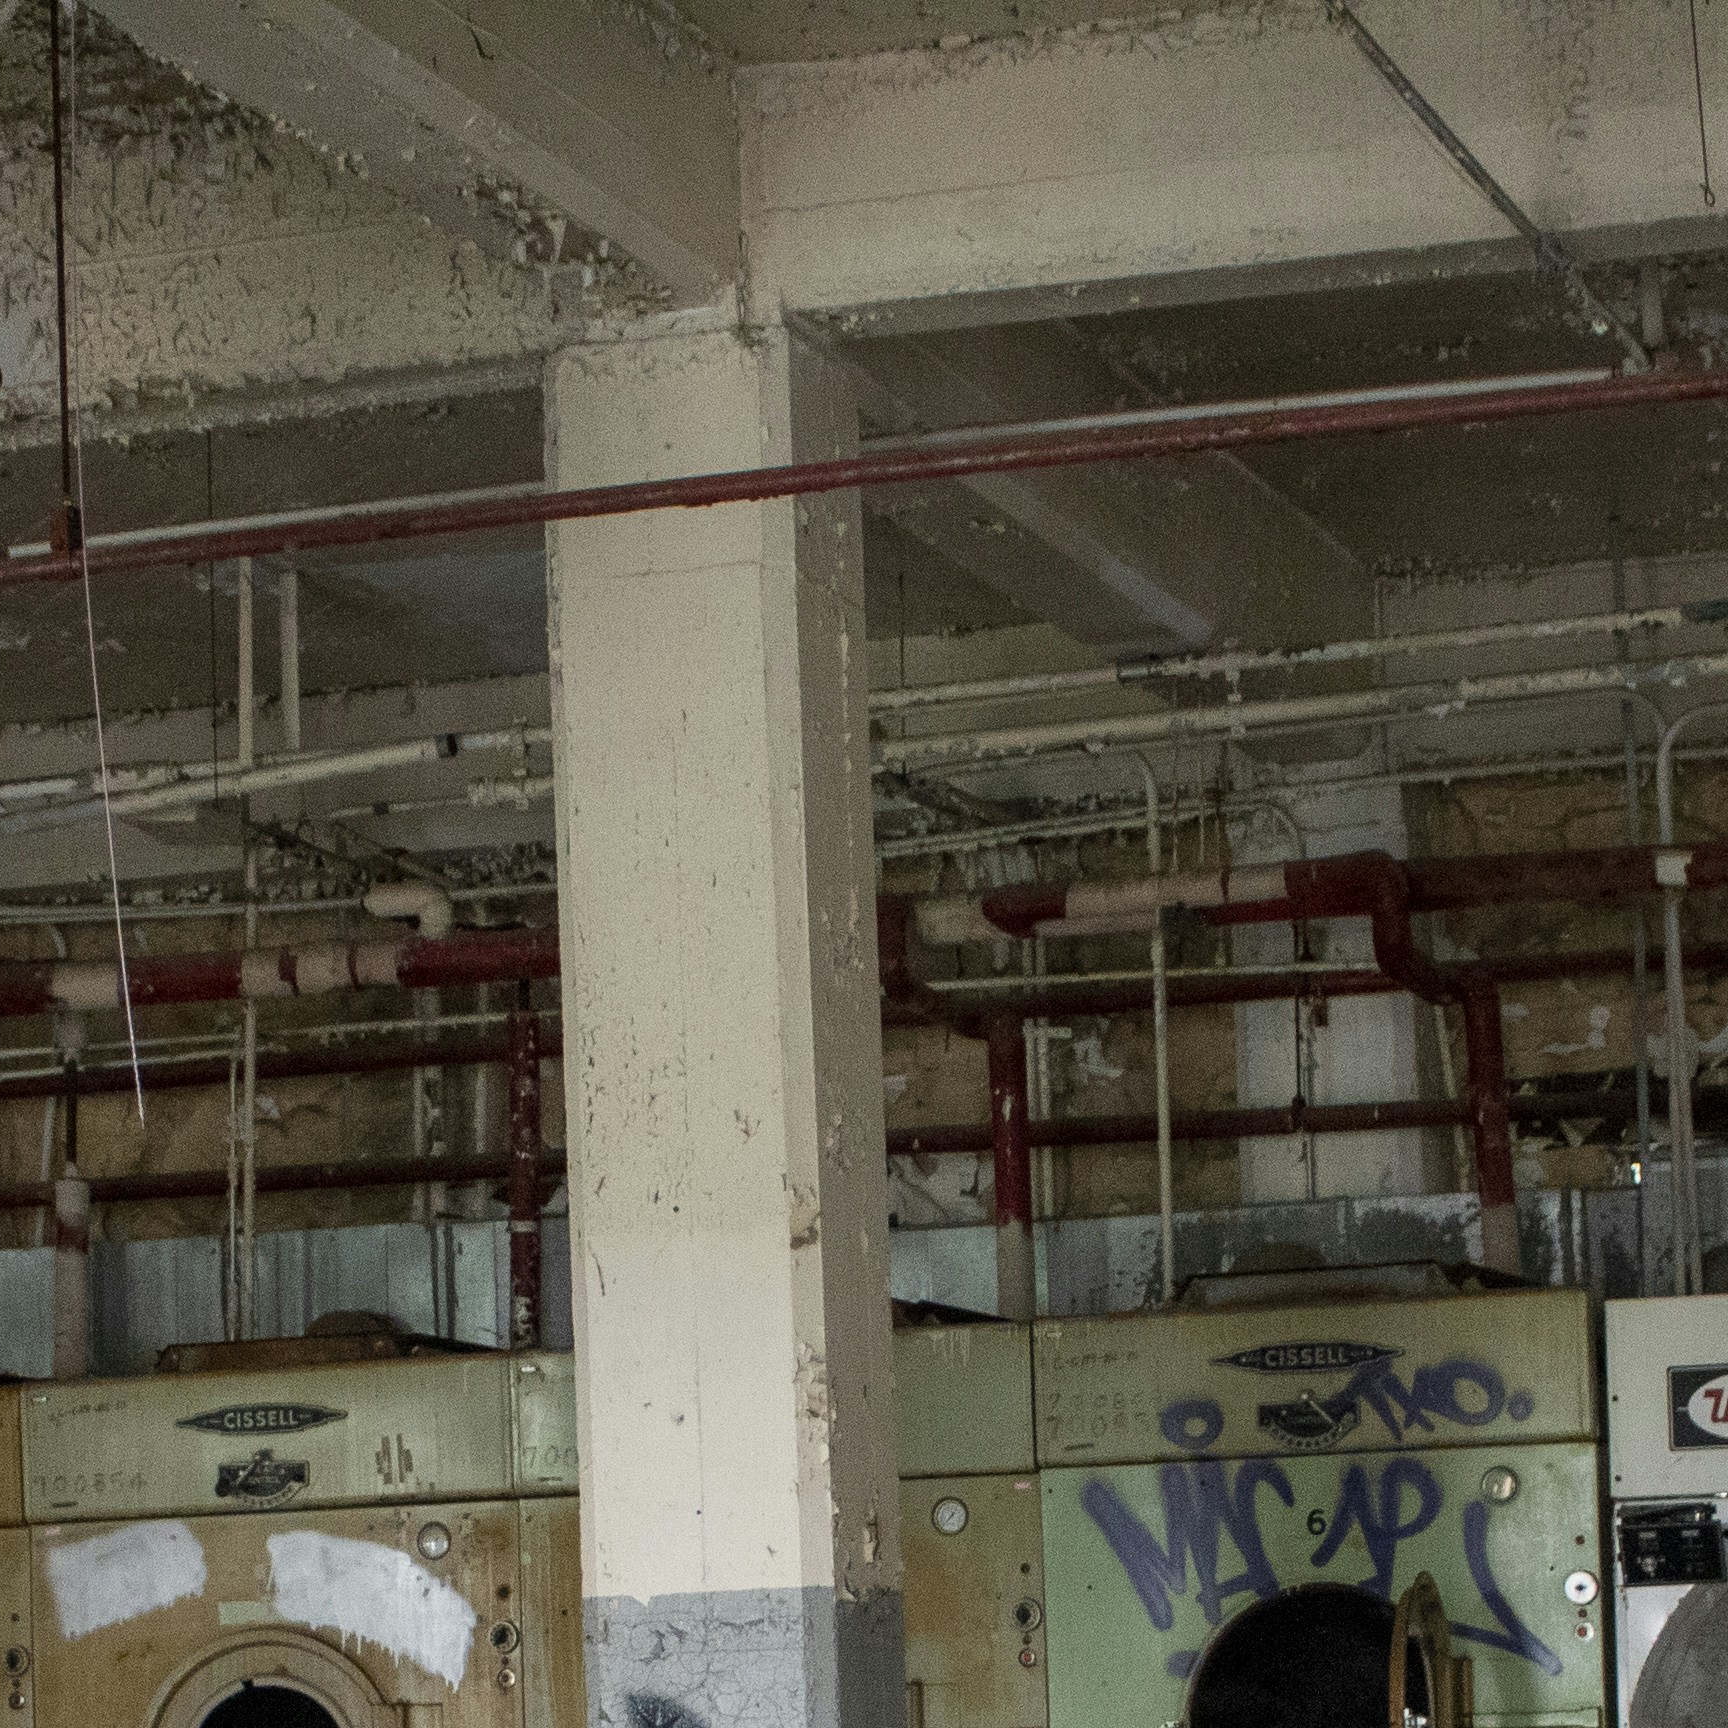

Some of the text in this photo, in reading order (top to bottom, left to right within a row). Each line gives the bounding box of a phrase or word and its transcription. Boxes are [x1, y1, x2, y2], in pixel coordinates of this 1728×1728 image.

[1264, 1347, 1348, 1368] CISSELL
[223, 1412, 299, 1430] CISSELL
[1306, 1508, 1327, 1536] 6
